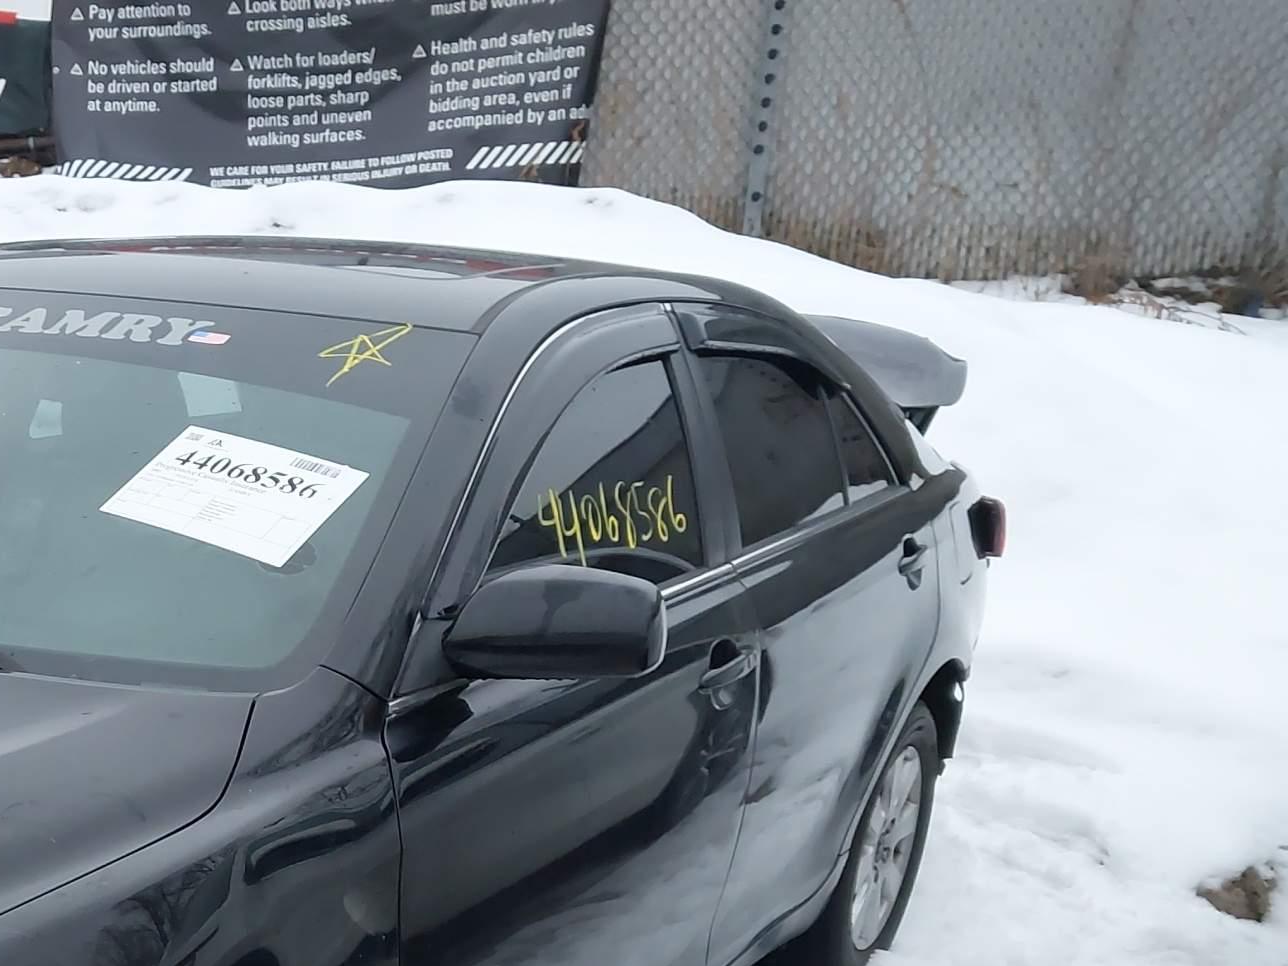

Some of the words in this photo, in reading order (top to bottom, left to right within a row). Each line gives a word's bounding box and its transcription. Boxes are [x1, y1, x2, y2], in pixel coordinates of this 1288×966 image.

[89, 4, 115, 23] Pay
[117, 3, 175, 19] attention
[178, 3, 191, 16] to
[245, 0, 277, 14] Look
[280, 0, 311, 12] both
[314, 0, 351, 11] ways
[431, 1, 467, 16] must
[469, 0, 487, 12] be
[88, 27, 119, 42] your
[121, 21, 212, 39] surroundings.
[246, 15, 304, 33] crossing
[307, 12, 352, 29] aisles.
[431, 37, 477, 56] Health
[480, 32, 508, 49] and
[510, 28, 555, 45] safety
[557, 22, 595, 39] rules
[87, 60, 108, 75] No
[111, 59, 167, 74] vehicles
[169, 57, 215, 74] should
[247, 54, 293, 70] Watch
[295, 52, 315, 67] for
[318, 47, 376, 66] loaders/
[430, 60, 449, 76] do
[451, 58, 475, 73] not
[478, 51, 523, 72] permit
[526, 45, 585, 64] children
[87, 80, 105, 94] be
[108, 78, 149, 93] driven
[153, 81, 166, 93] or
[170, 77, 217, 92] started
[247, 73, 303, 89] forklifts,
[304, 69, 352, 90] jagged
[355, 67, 402, 85] edges,
[430, 80, 443, 95] in
[446, 77, 469, 93] the
[472, 71, 525, 88] auction
[528, 66, 561, 86] yard
[563, 65, 580, 79] or
[87, 99, 101, 112] at
[104, 98, 161, 115] anytime.
[247, 94, 284, 109] loose
[287, 93, 327, 110] parts,
[329, 89, 370, 106] sharp
[429, 95, 480, 114] bidding
[483, 92, 521, 108] area,
[523, 88, 559, 104] even
[561, 84, 573, 100] if
[247, 115, 289, 131] points
[292, 110, 318, 125] and
[321, 109, 372, 124] uneven
[428, 110, 524, 132] accompanied
[527, 108, 545, 125] by
[547, 107, 566, 122] an
[247, 132, 300, 148] walking
[303, 128, 366, 144] surfaces.
[209, 166, 225, 177] WE
[226, 165, 249, 176] CARE
[251, 164, 268, 175] FOR
[269, 164, 295, 174] YOUR
[331, 159, 365, 170] FAILURE
[368, 158, 379, 168] TO
[381, 152, 416, 165] FOLLOW
[417, 149, 453, 160] POSTED
[175, 450, 328, 499] 44068586
[538, 475, 687, 567] 44068586
